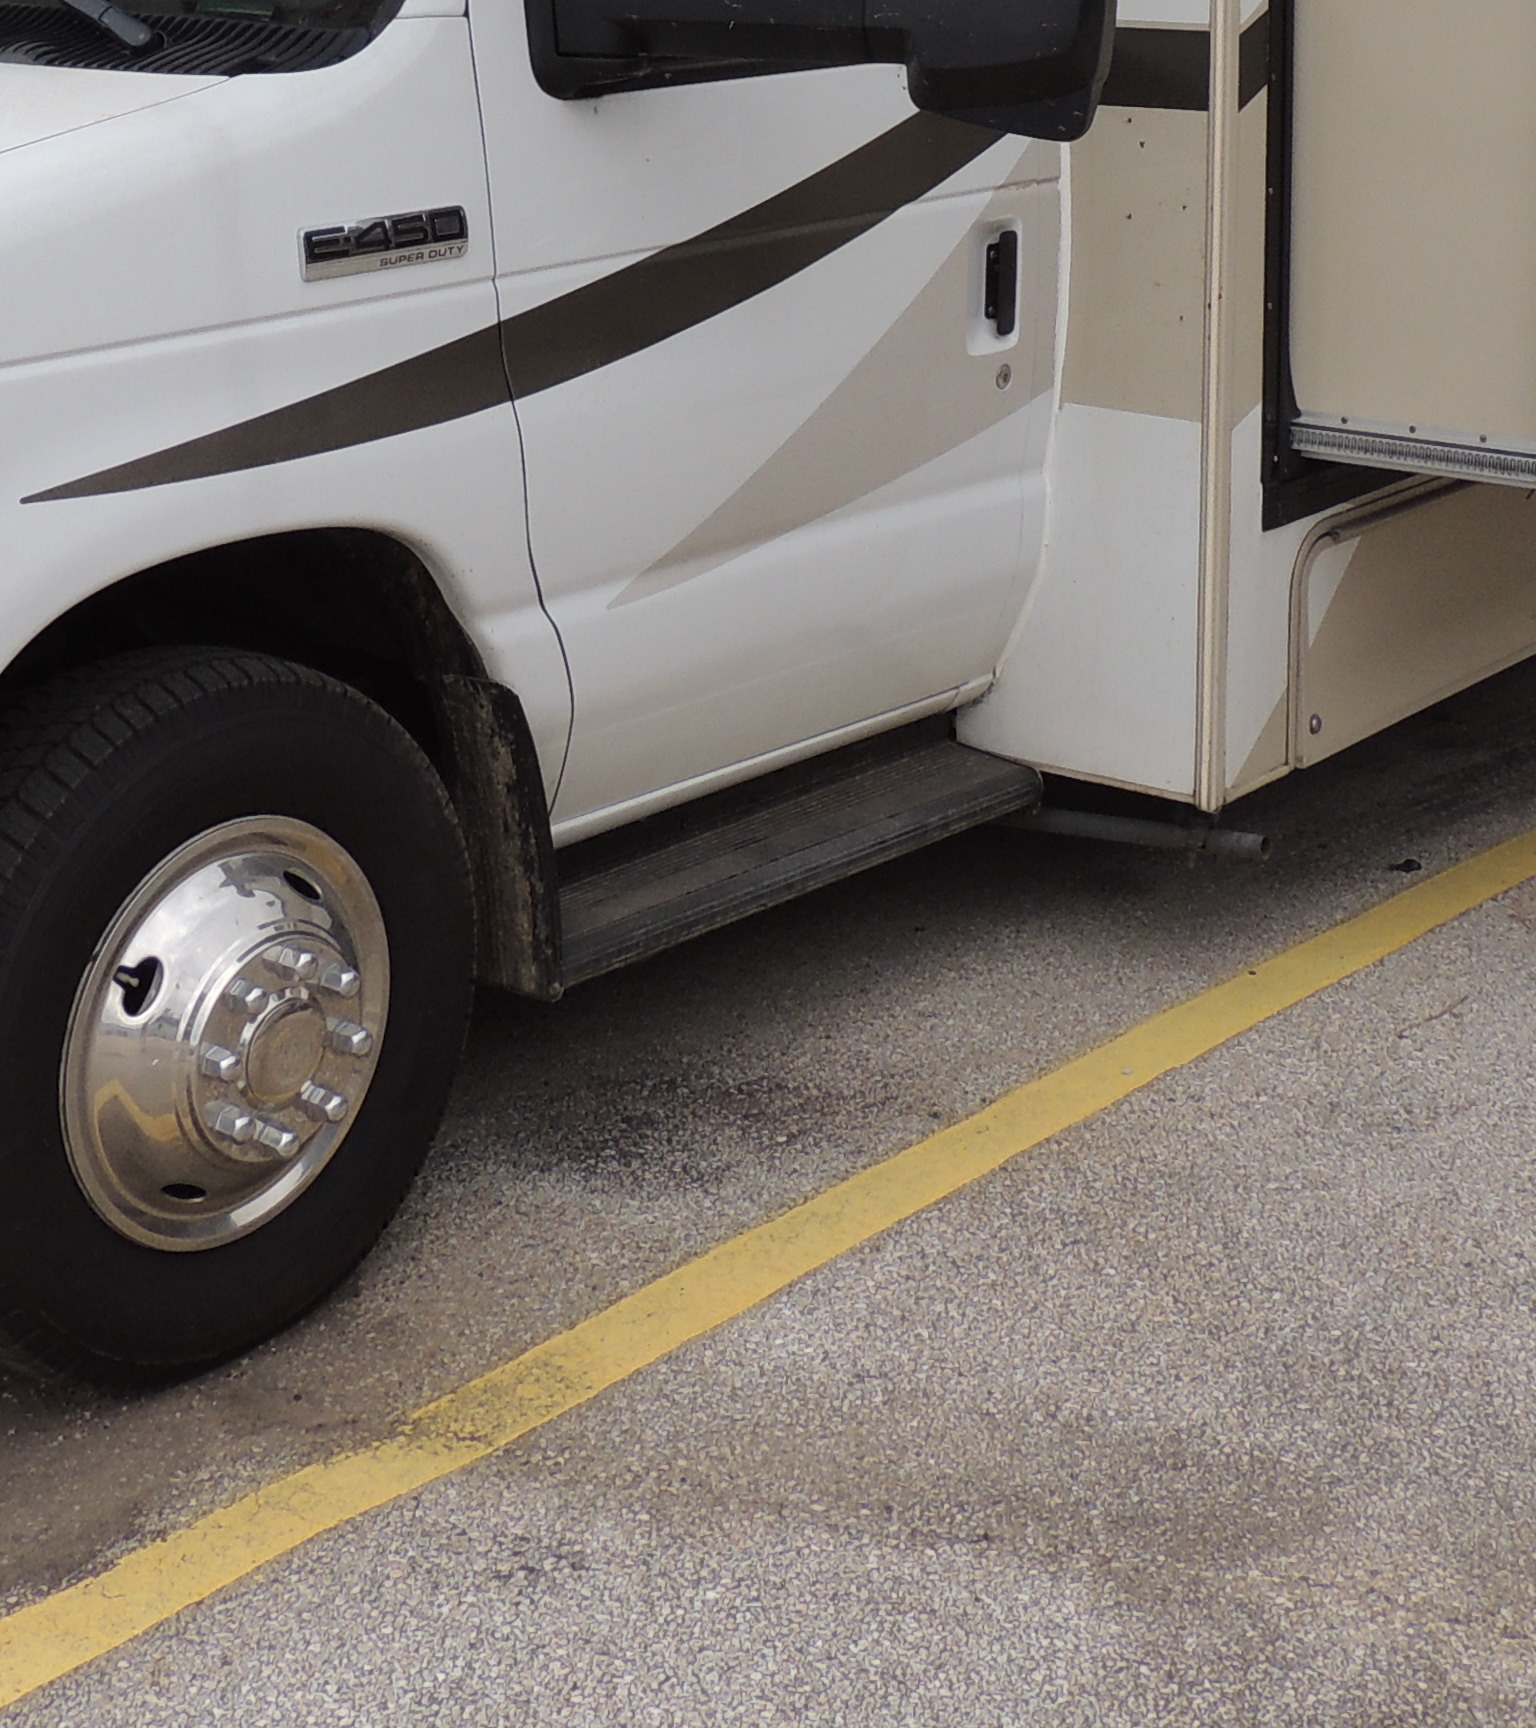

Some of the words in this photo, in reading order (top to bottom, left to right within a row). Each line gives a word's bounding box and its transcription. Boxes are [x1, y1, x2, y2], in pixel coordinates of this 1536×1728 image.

[304, 205, 468, 265] E-450
[379, 251, 424, 268] SUPER
[428, 245, 465, 260] DUTY
